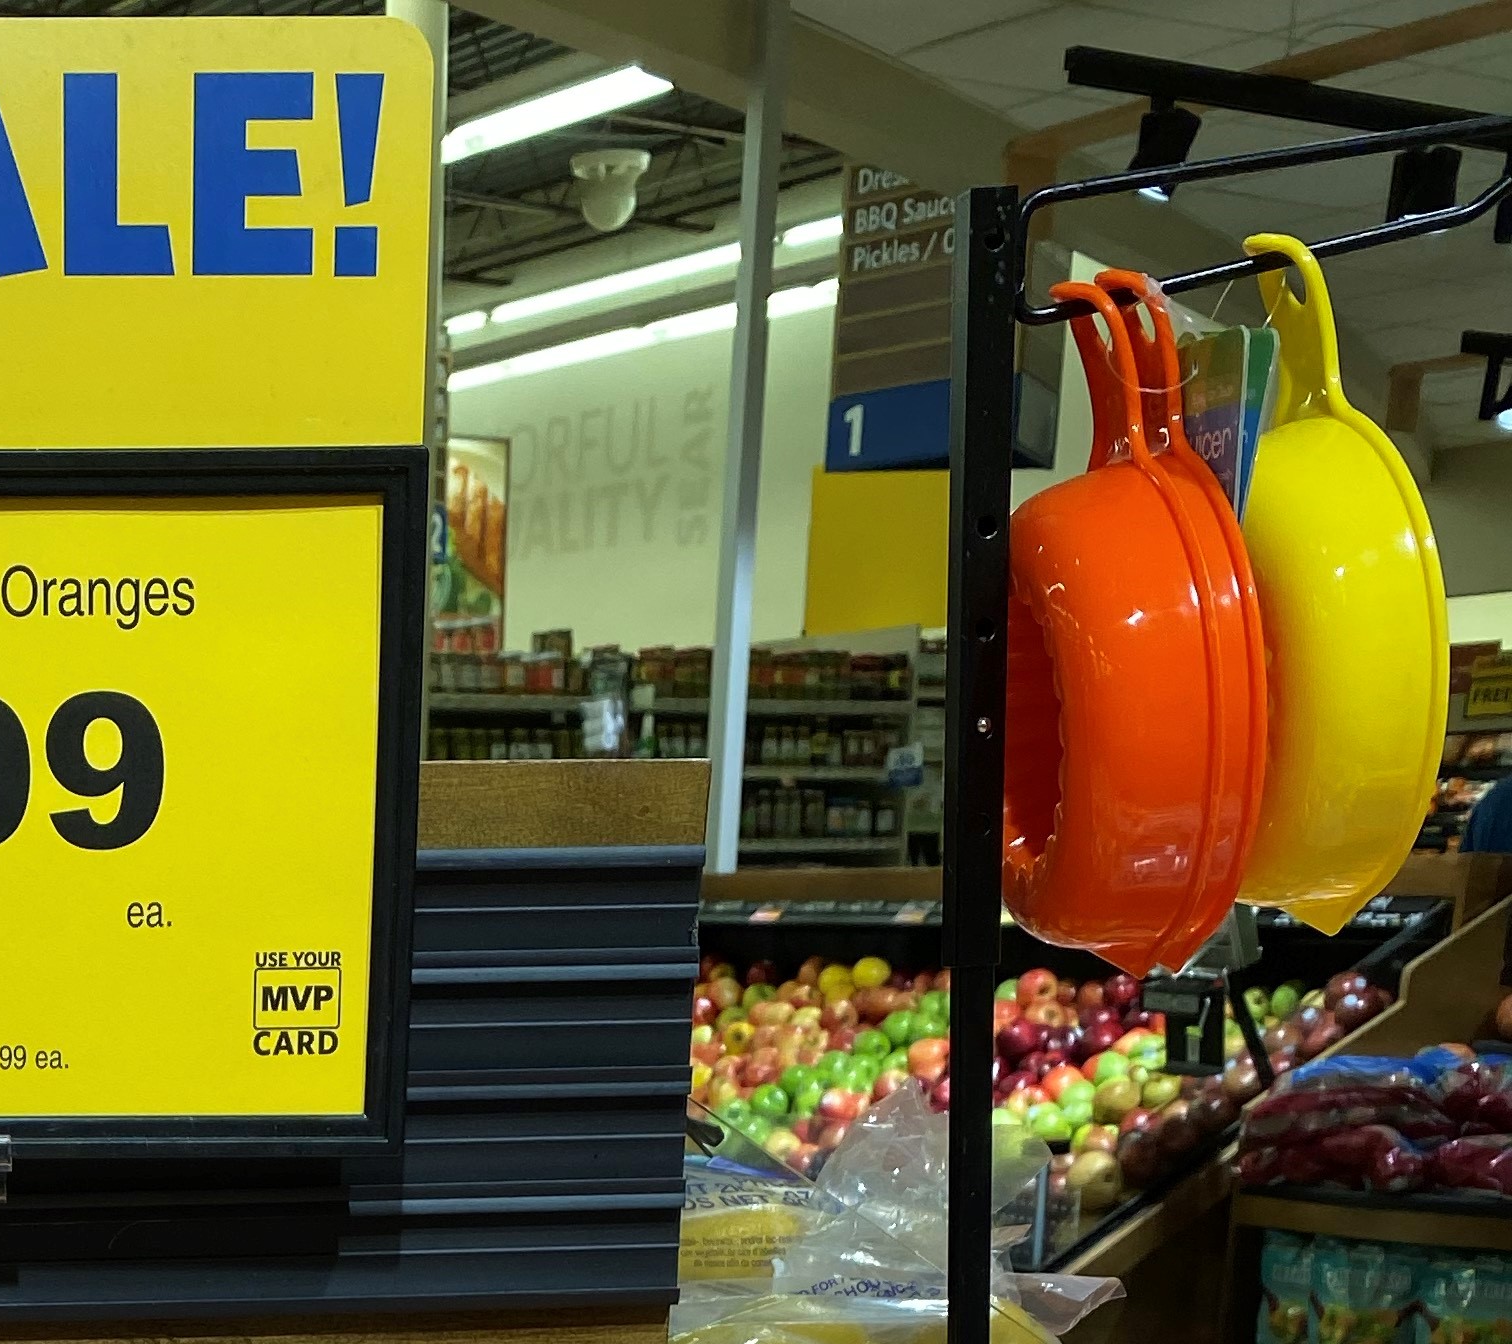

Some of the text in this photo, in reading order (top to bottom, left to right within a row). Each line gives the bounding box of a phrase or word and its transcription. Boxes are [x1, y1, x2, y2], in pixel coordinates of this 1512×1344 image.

[855, 202, 897, 233] BBQ
[852, 240, 919, 272] Pickles
[509, 396, 669, 492] ORFUL
[843, 404, 864, 456] 1
[508, 474, 672, 561] ALITY
[0, 566, 196, 629] Oranges
[126, 899, 172, 929] ea.
[254, 951, 342, 967] USE YOUR
[261, 984, 332, 1012] MVP
[252, 1030, 339, 1057] CARD
[34, 1053, 69, 1071] ea.
